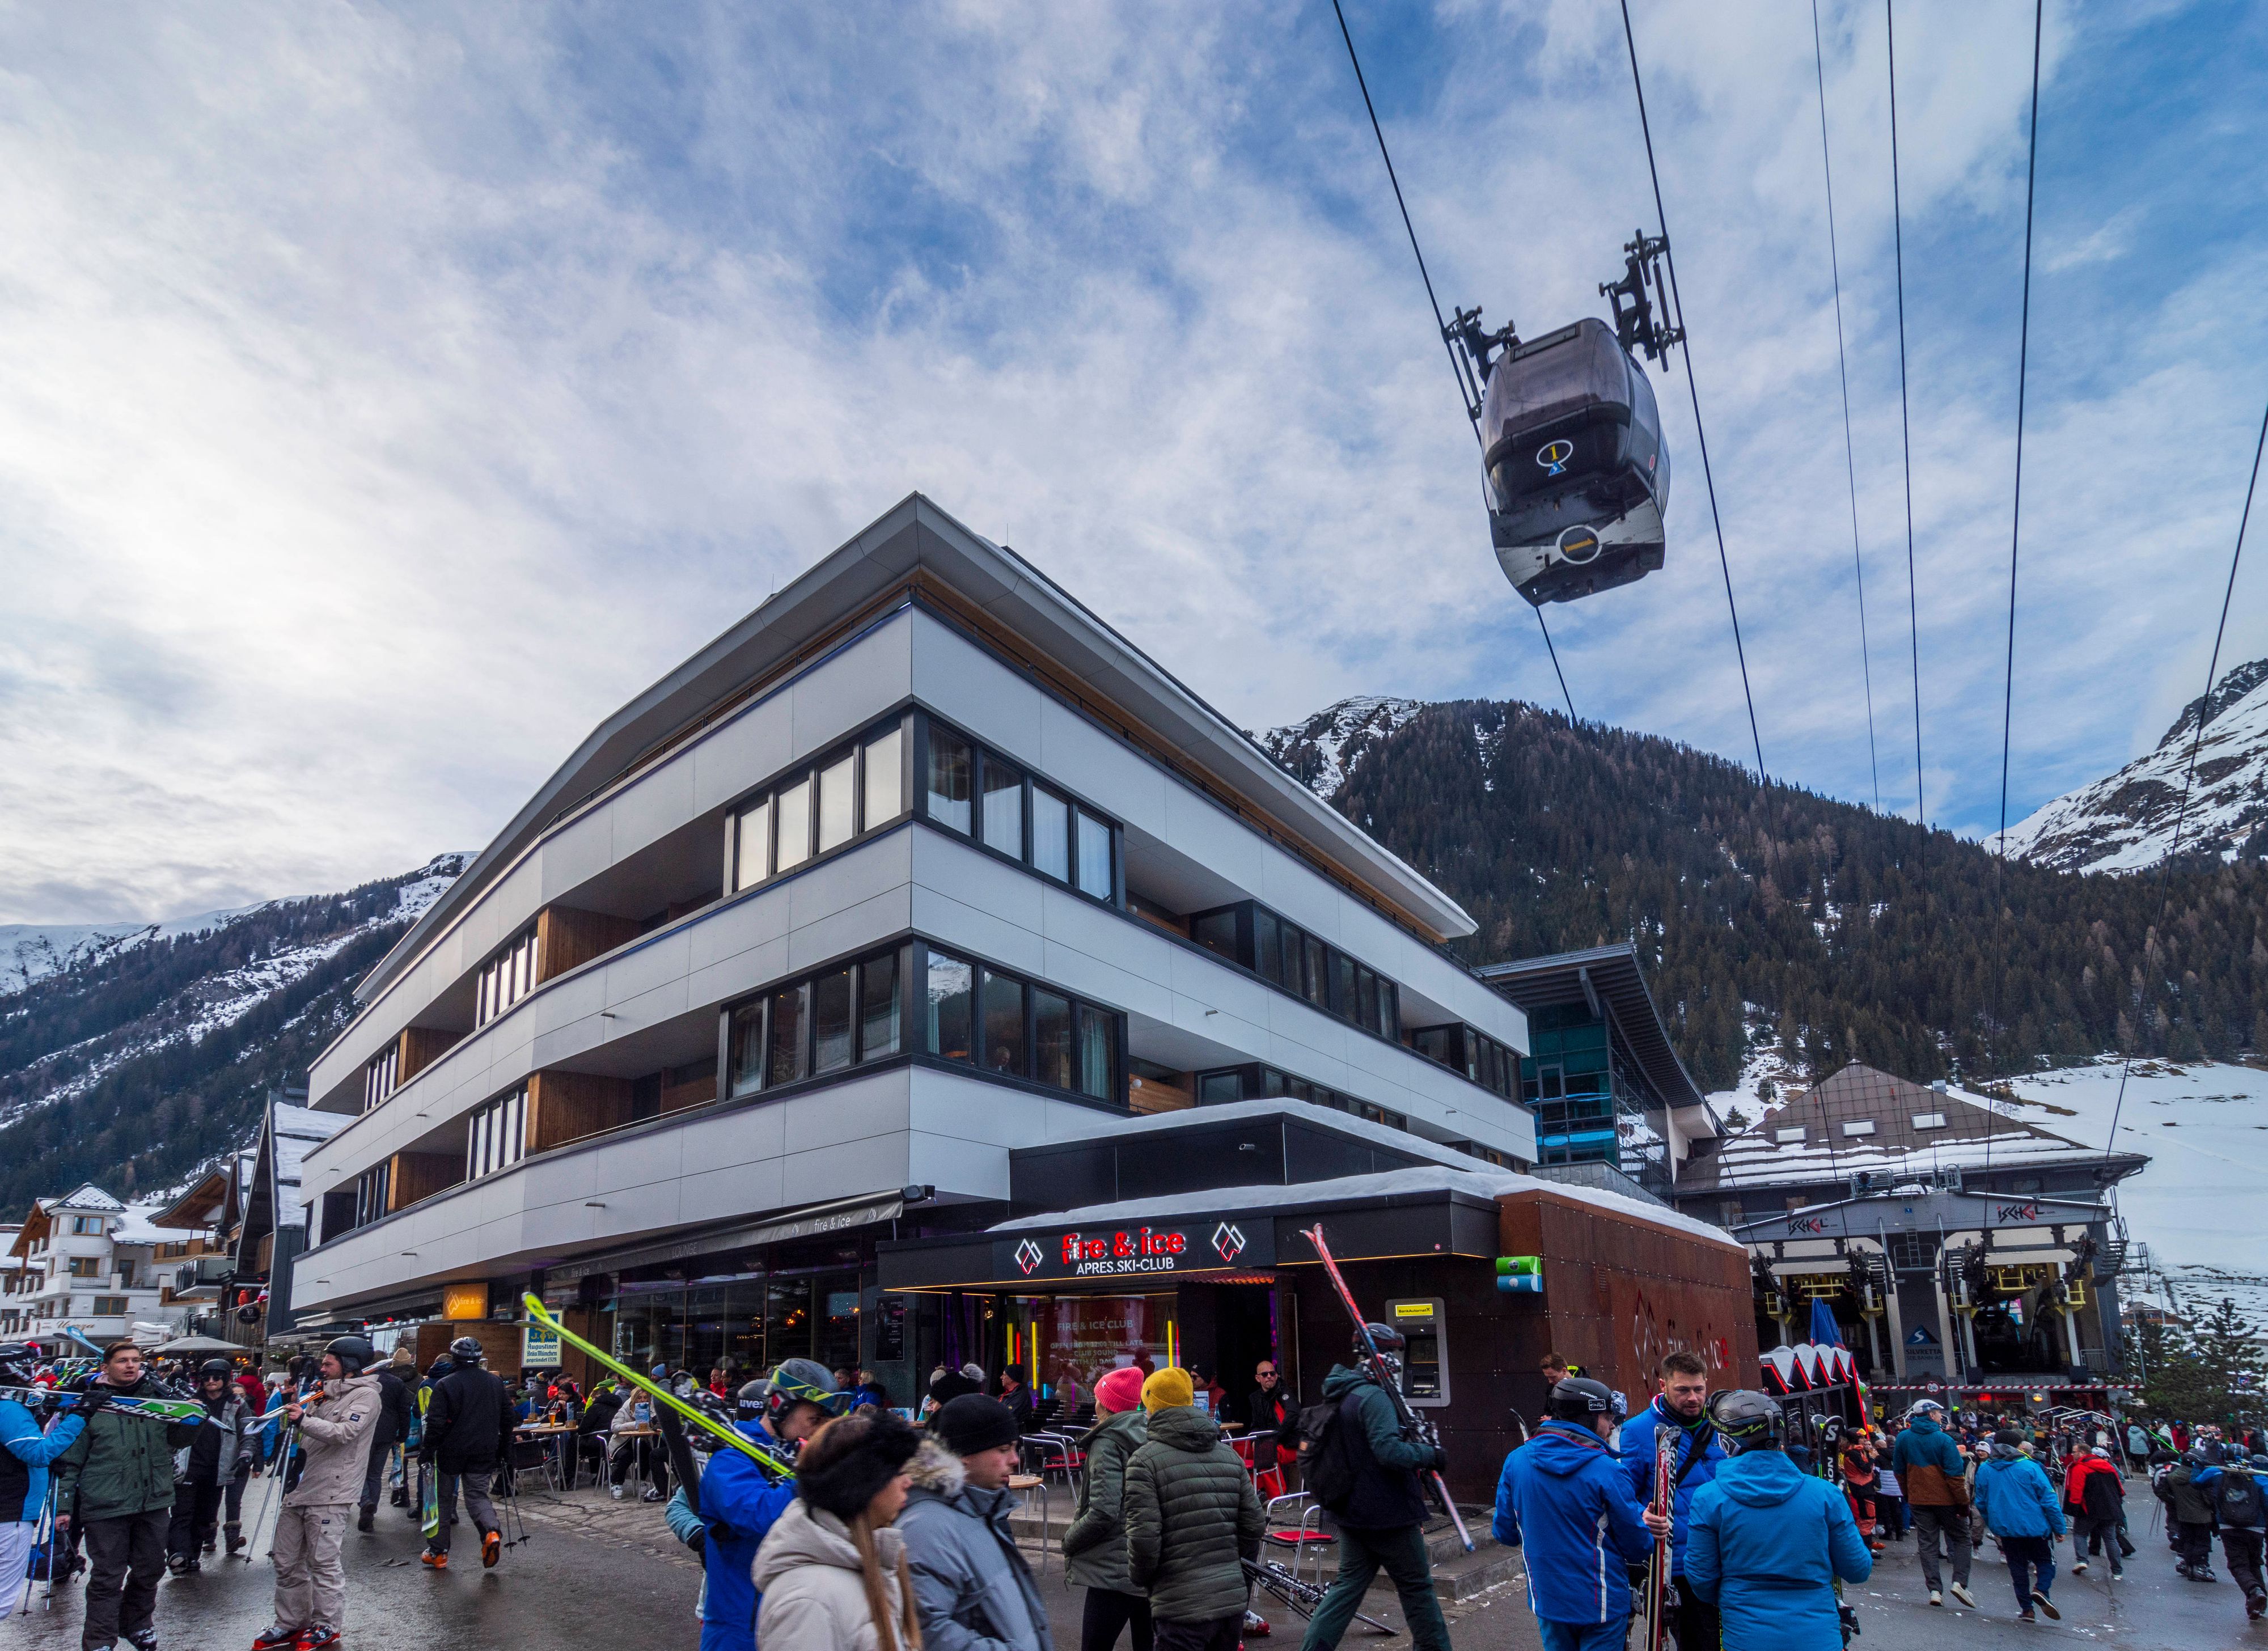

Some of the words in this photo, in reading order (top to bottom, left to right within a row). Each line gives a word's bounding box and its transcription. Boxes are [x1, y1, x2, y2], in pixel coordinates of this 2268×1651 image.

[1550, 444, 1558, 461] 1
[814, 1219, 827, 1232] fire
[830, 1217, 835, 1229] &
[837, 1214, 850, 1227] ice
[672, 1242, 697, 1258] LOUNGE
[1113, 1231, 1135, 1258] &
[1140, 1227, 1186, 1255] ice
[1076, 1257, 1174, 1275] APRES.SKI-CLUB
[1057, 1322, 1079, 1331] FIRE
[1089, 1321, 1106, 1330] ICE
[1107, 1319, 1134, 1329] CLUB
[102, 1401, 181, 1423] ORDICA
[1666, 1446, 1678, 1547] BLIZZARD
